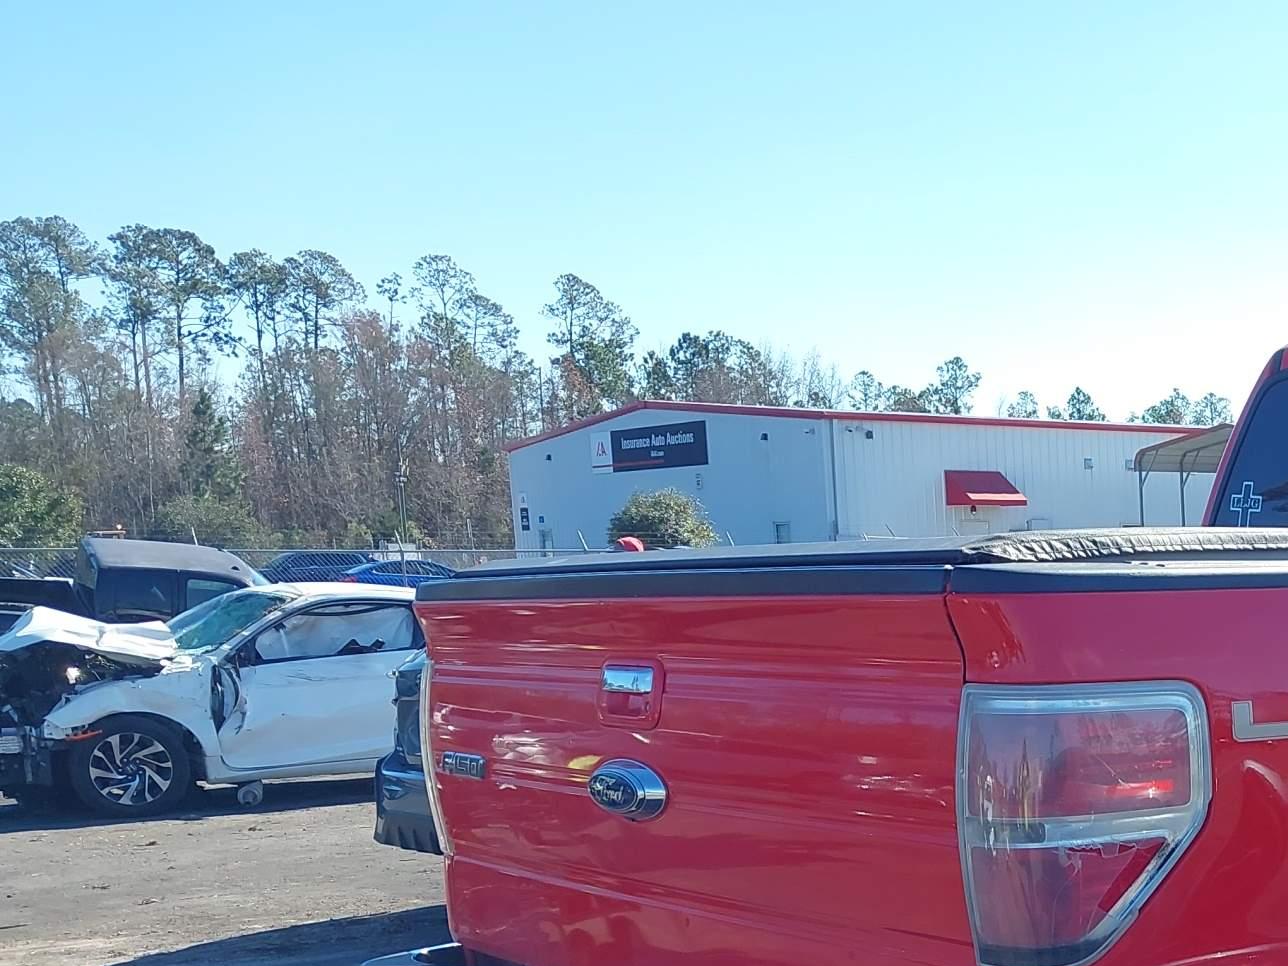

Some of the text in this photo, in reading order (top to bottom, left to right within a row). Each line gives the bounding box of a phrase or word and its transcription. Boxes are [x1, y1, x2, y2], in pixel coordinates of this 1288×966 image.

[621, 430, 694, 450] Insurance Auto Auctions
[590, 776, 625, 804] Ford
